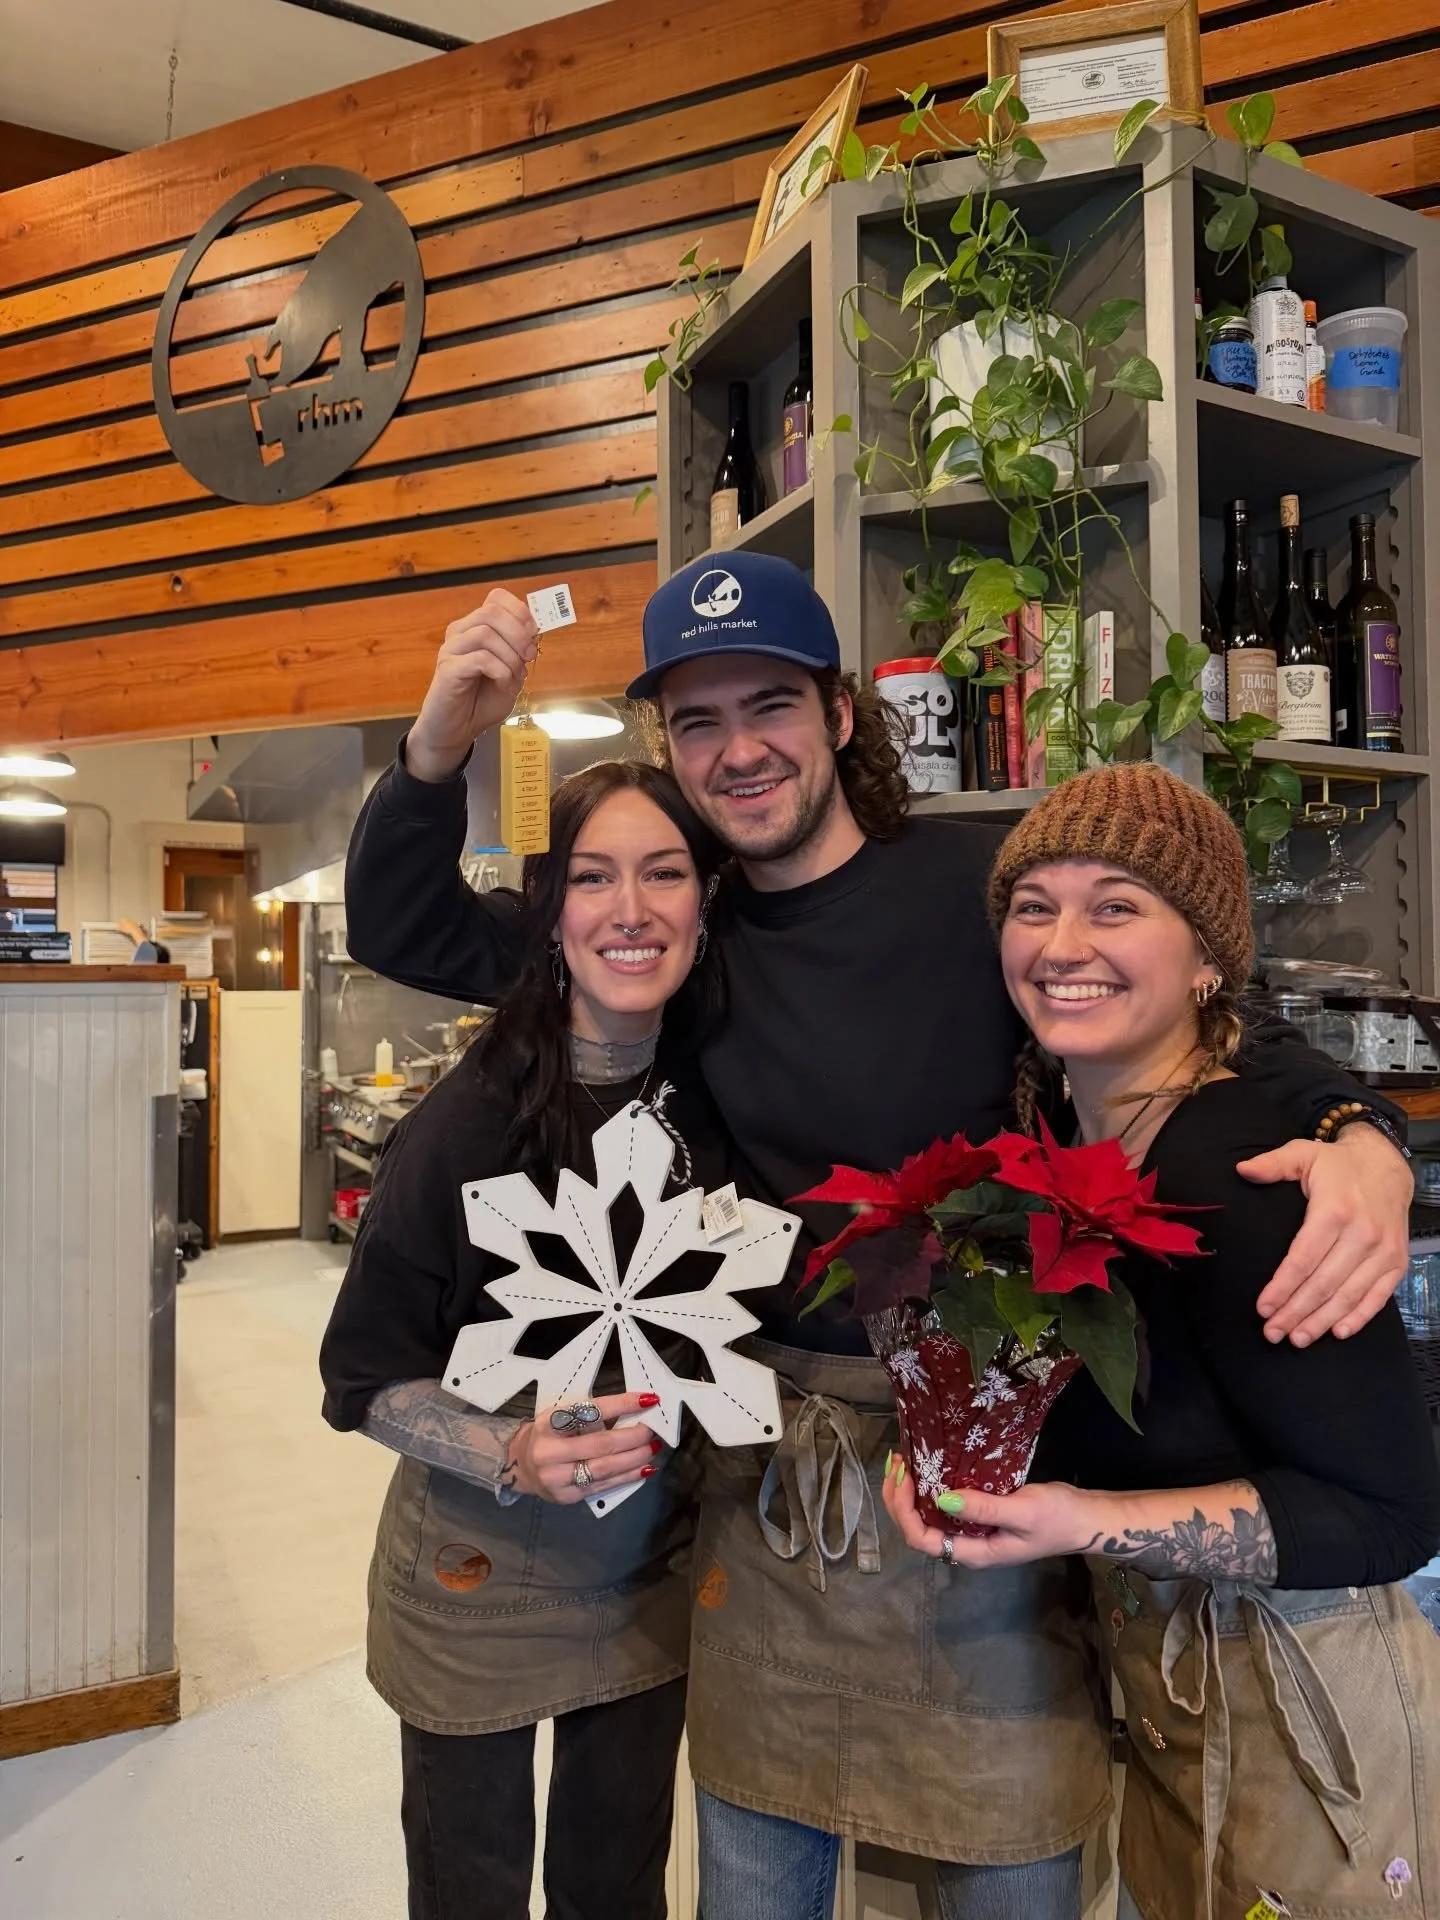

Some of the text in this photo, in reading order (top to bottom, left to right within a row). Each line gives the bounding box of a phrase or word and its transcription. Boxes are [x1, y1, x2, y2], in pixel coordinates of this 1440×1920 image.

[298, 392, 362, 432] rhm
[681, 618, 757, 640] red hills market
[1101, 627, 1112, 695] FIZ
[1240, 674, 1277, 690] TRACTO
[900, 685, 954, 716] SO
